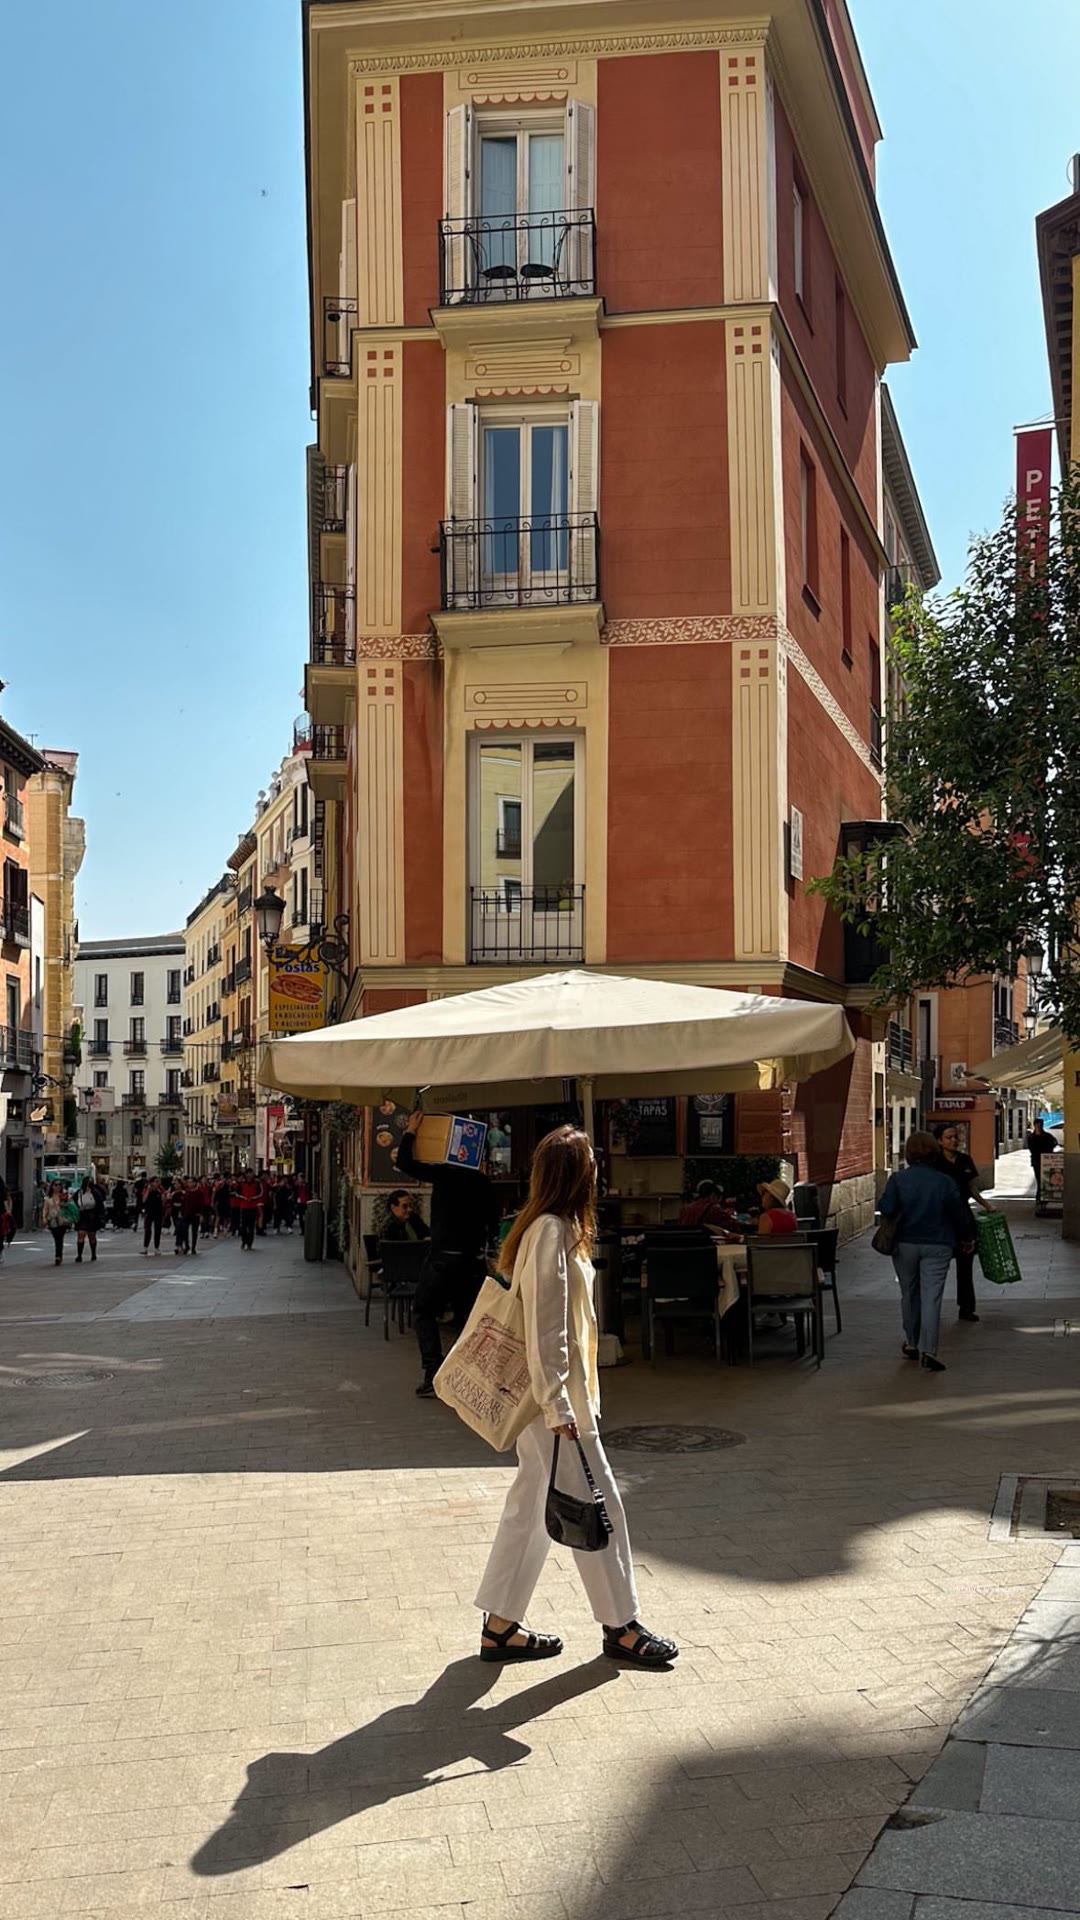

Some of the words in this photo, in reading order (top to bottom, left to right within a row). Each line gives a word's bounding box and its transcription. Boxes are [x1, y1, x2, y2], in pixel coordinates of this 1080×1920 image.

[1025, 469, 1043, 607] PETI
[639, 1105, 668, 1116] TAPAS
[938, 1101, 966, 1109] TAPAS
[454, 1367, 505, 1415] SHAKESPEARE
